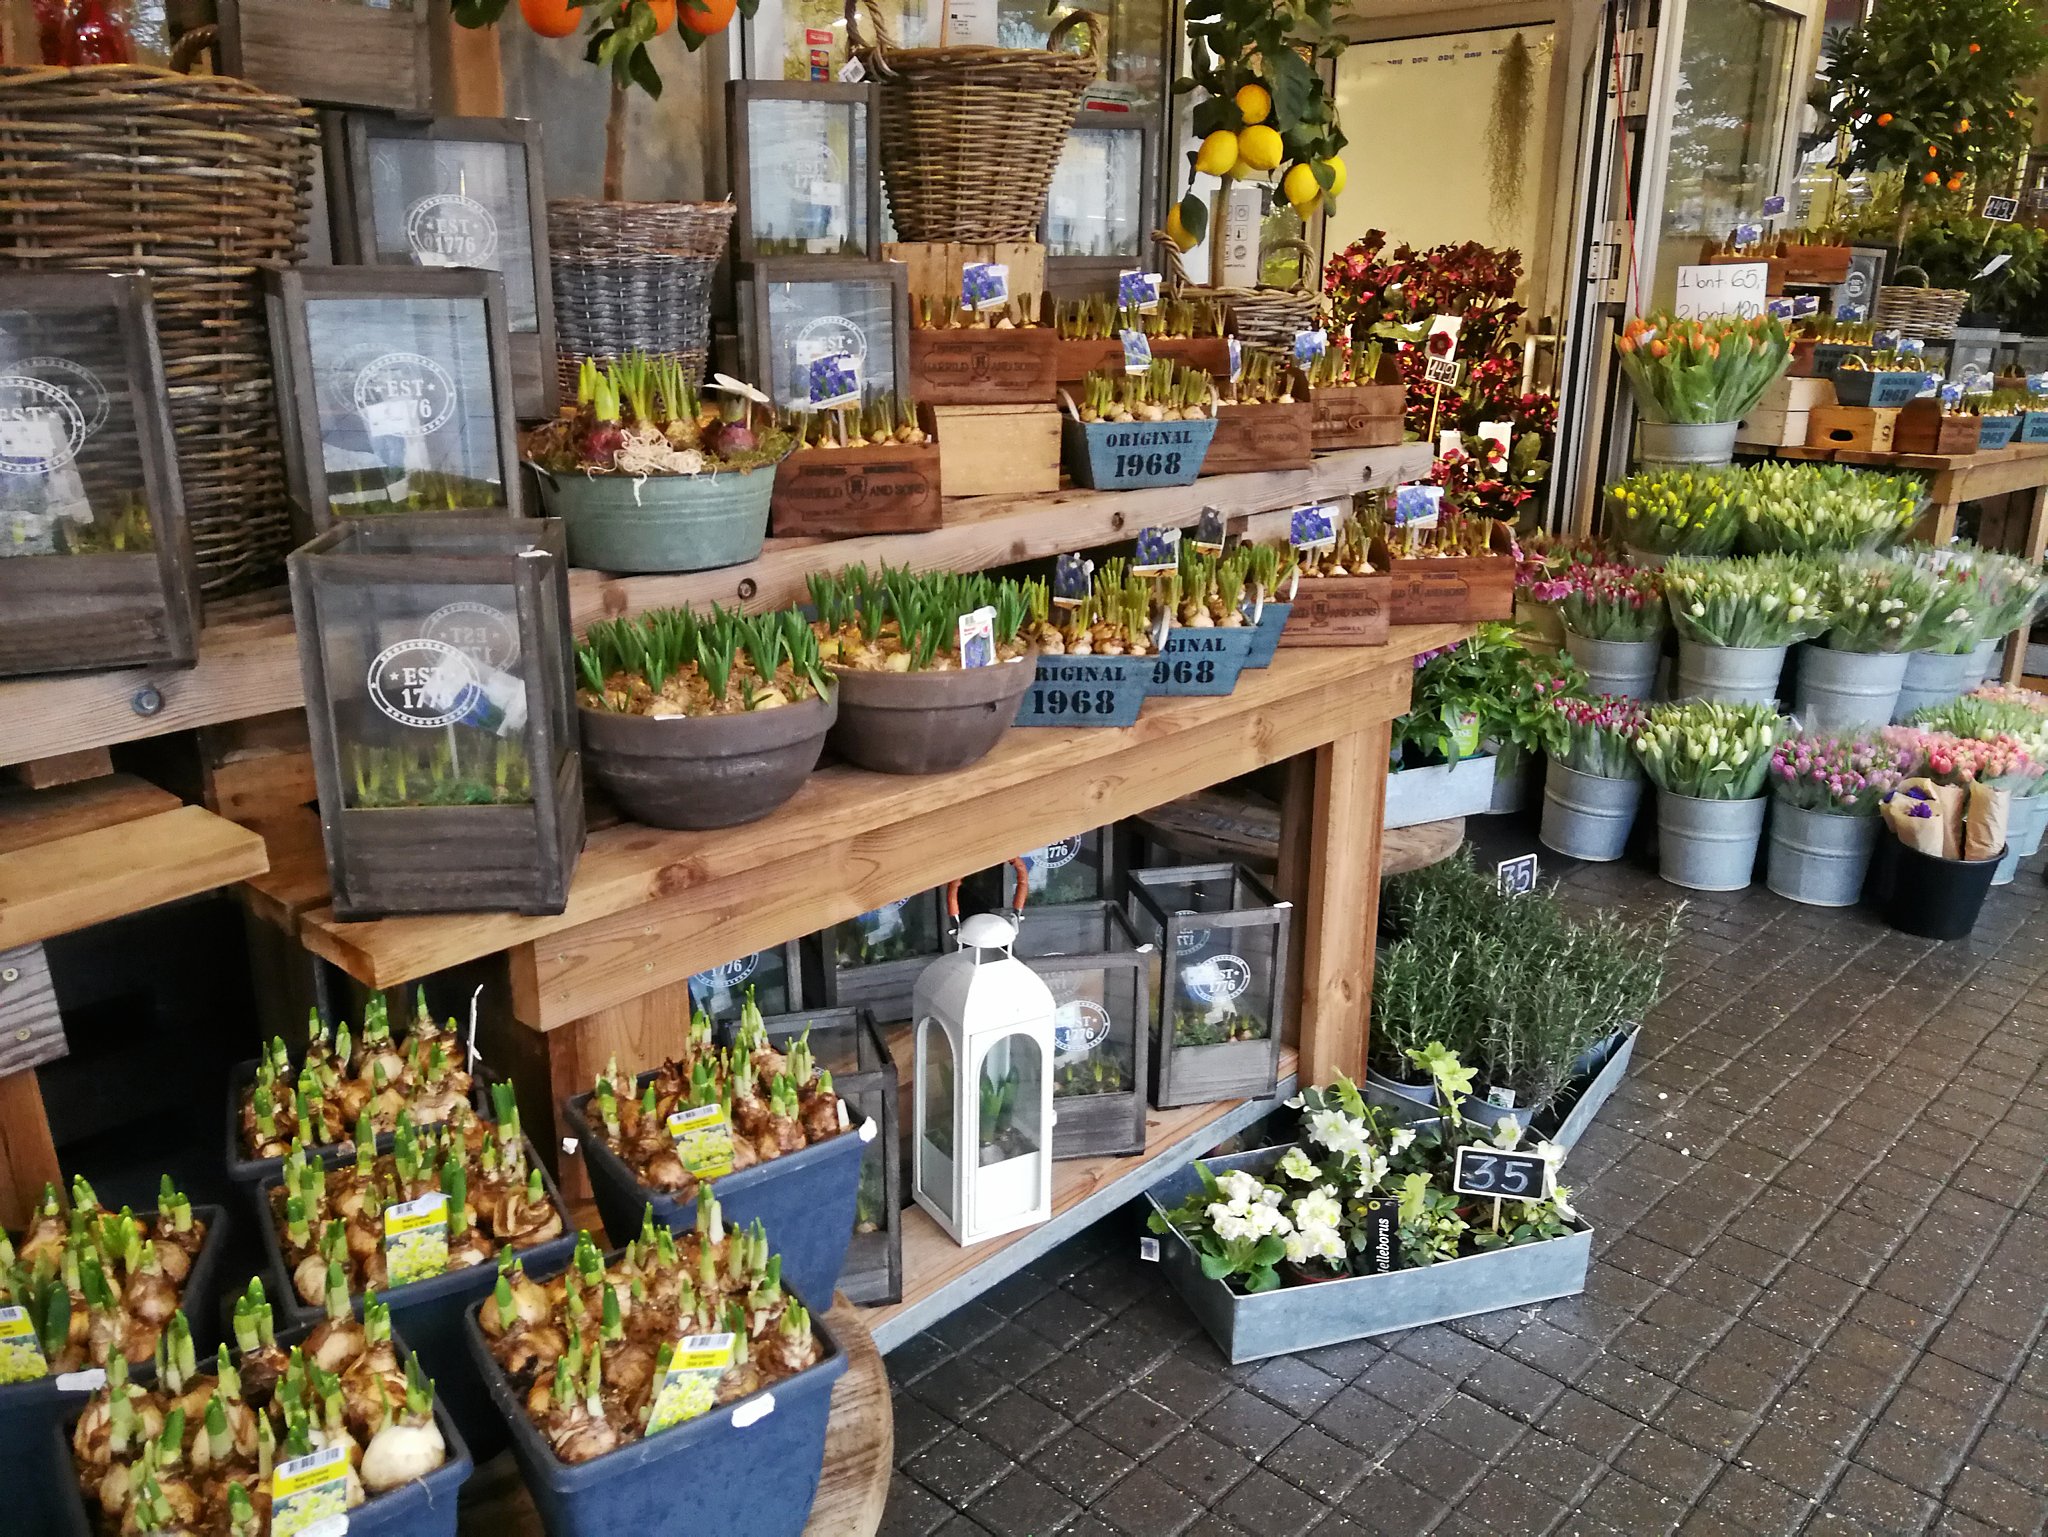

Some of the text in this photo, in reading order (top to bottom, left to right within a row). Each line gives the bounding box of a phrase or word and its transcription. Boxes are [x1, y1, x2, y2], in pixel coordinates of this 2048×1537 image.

[435, 218, 470, 234] EST
[435, 236, 476, 254] 1776
[1679, 270, 1690, 288] 1
[1679, 304, 1690, 320] 2
[386, 379, 424, 397] EST
[1106, 430, 1193, 448] ORIGINAL
[1114, 452, 1182, 478] 1968
[1165, 638, 1227, 654] GINAL
[1034, 666, 1127, 682] RIGINAL
[1152, 660, 1215, 684] 968
[1032, 689, 1116, 715] 1968
[1502, 860, 1531, 891] 35
[1208, 980, 1236, 993] 1776
[1064, 1027, 1095, 1042] 1776
[1464, 1154, 1534, 1194] 35
